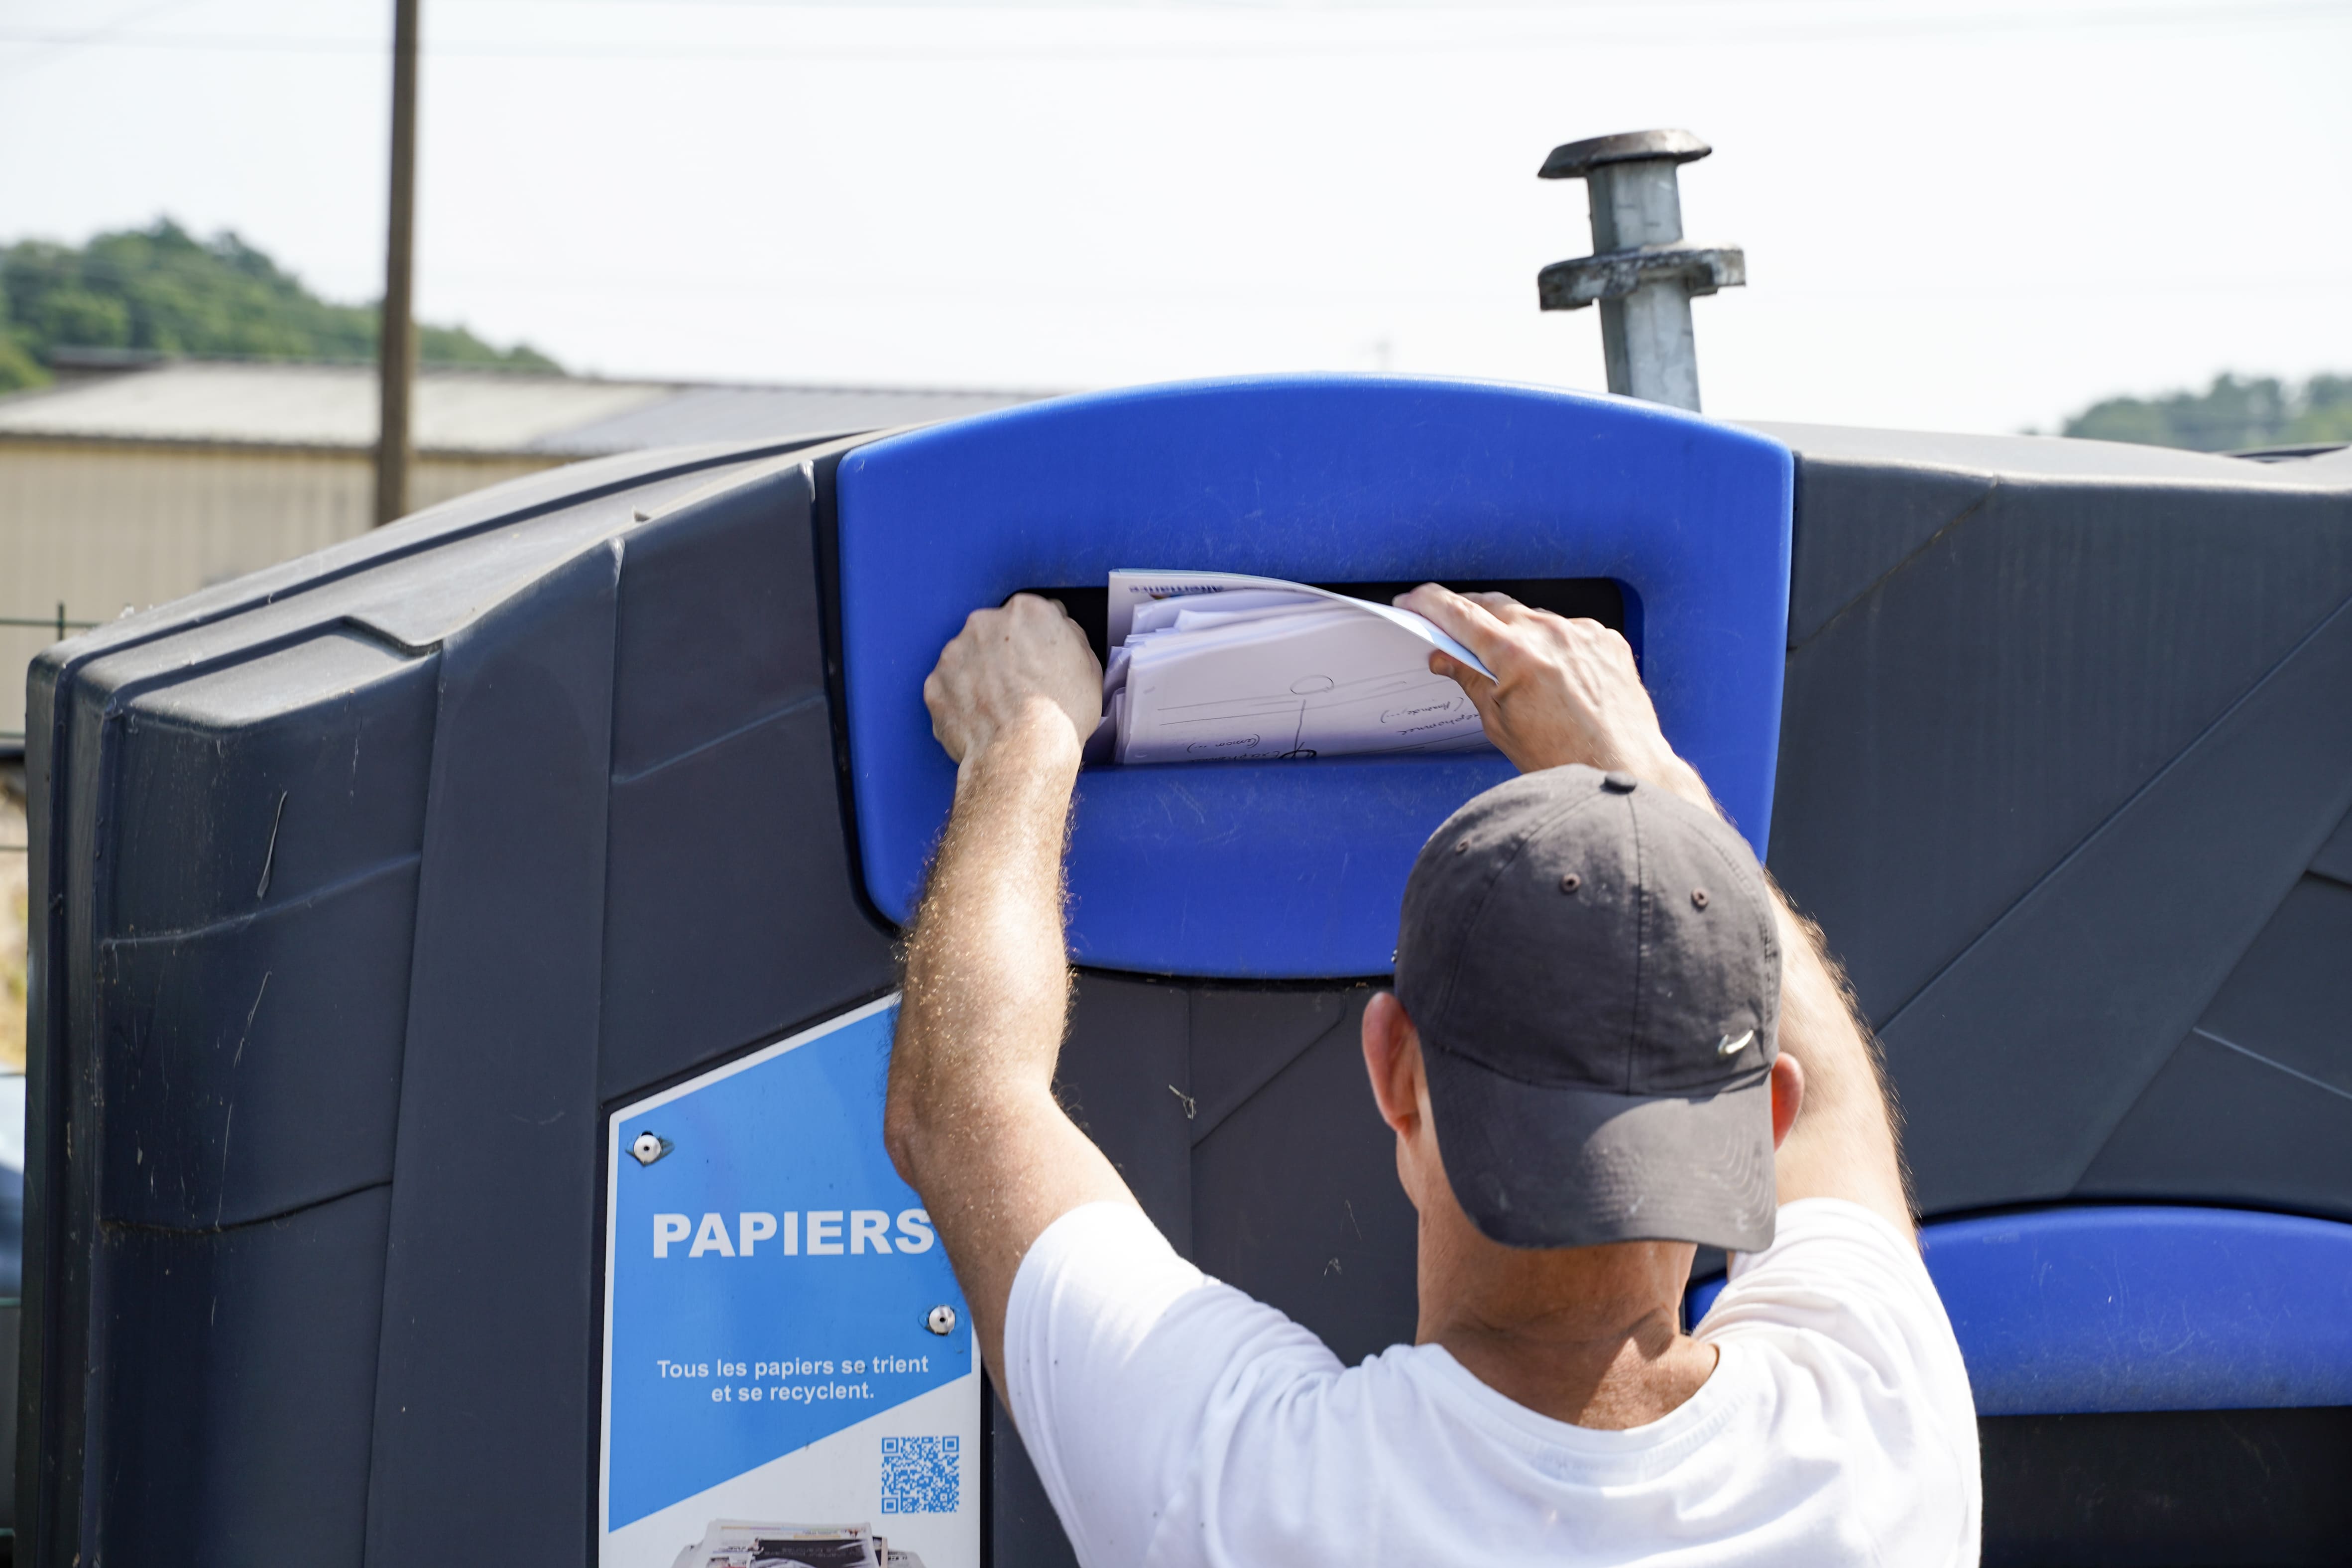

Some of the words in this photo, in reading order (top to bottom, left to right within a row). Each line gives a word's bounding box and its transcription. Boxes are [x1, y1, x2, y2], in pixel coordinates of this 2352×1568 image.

[653, 1208, 935, 1258] PAPIERS
[657, 1360, 709, 1378] Tous
[717, 1359, 747, 1376] les
[755, 1357, 834, 1380] papiers
[841, 1360, 865, 1374] se
[872, 1355, 929, 1373] trient
[711, 1386, 731, 1402] et
[738, 1387, 762, 1402] se
[770, 1381, 875, 1405] recyclent.
